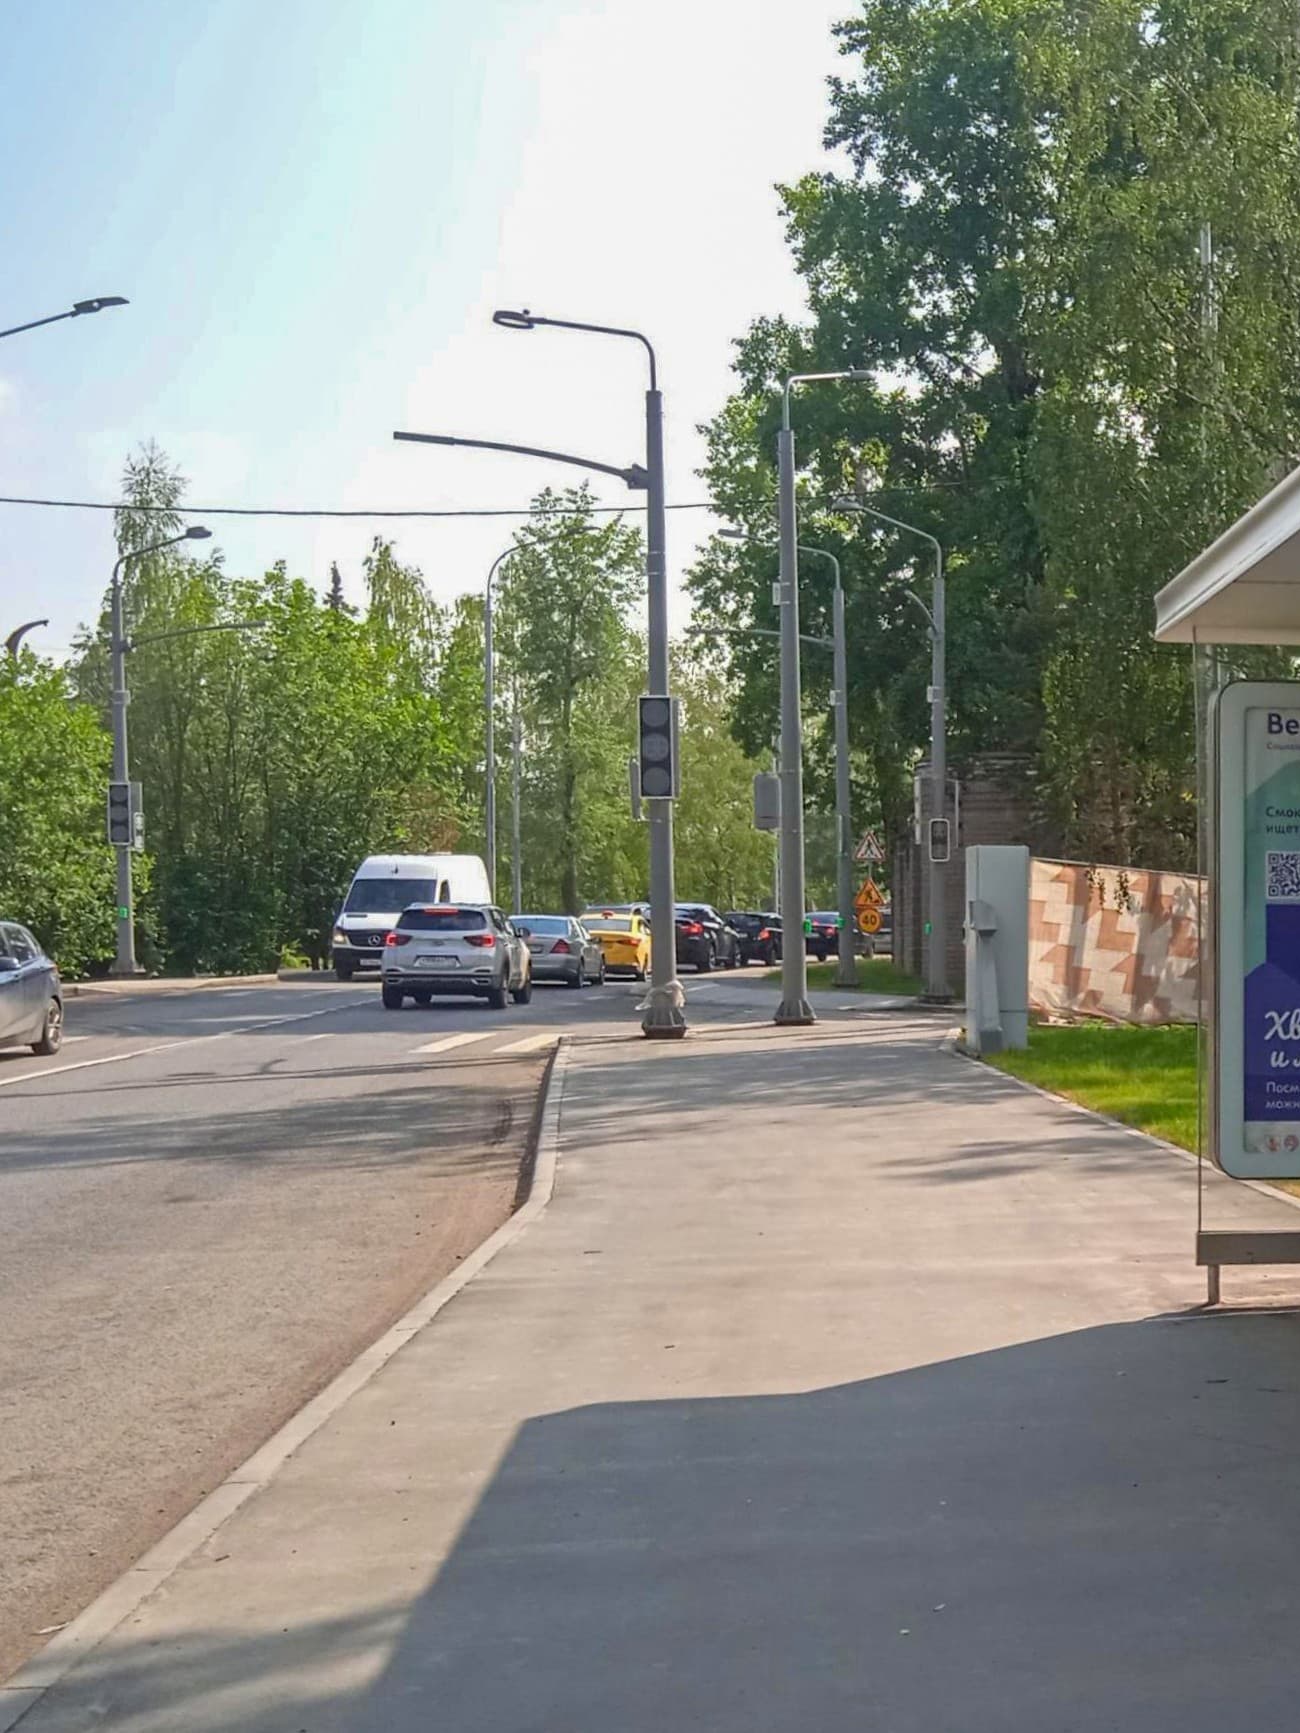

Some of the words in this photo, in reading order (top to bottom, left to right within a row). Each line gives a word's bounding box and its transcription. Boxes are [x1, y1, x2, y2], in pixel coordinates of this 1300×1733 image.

[1266, 825, 1298, 834] ищет
[862, 914, 878, 926] 40
[1271, 1050, 1290, 1068] и
